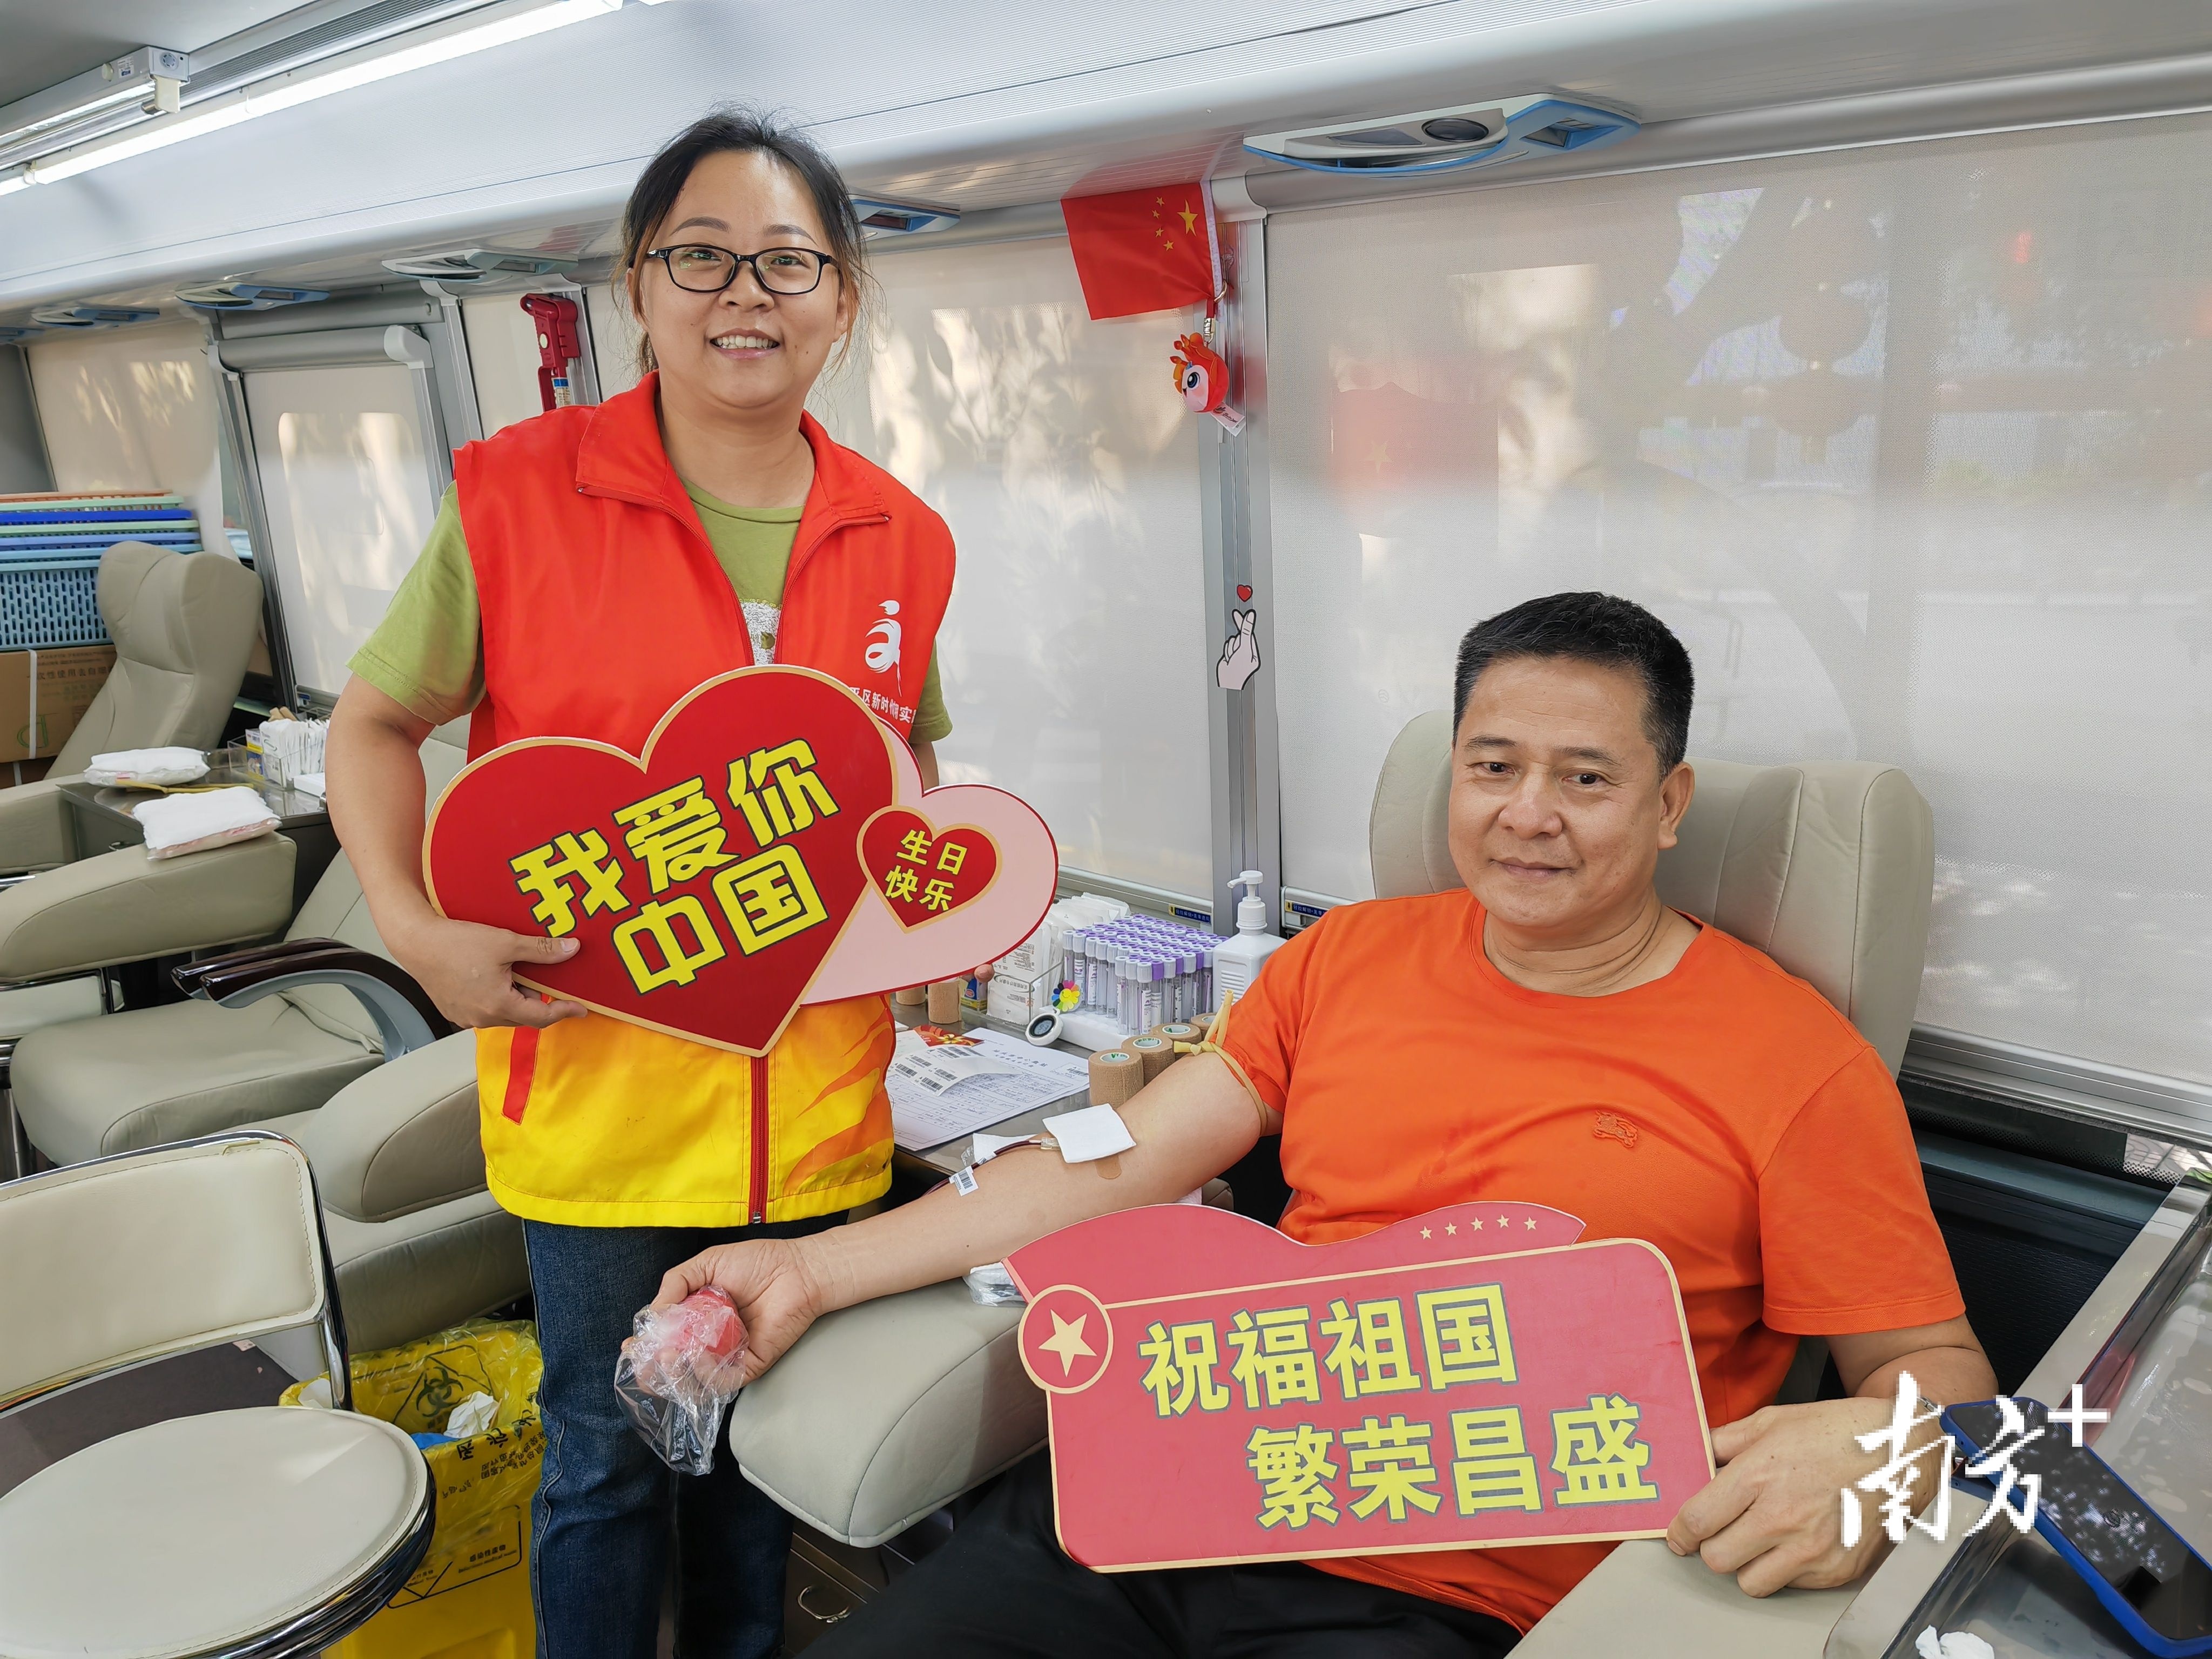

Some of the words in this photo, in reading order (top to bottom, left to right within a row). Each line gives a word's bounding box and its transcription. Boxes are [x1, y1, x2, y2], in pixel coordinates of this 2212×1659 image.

[510, 738, 840, 939] 我爱你
[884, 865, 955, 912] 快乐
[896, 829, 968, 875] 生日
[612, 843, 830, 995] 中国
[1138, 1283, 1518, 1418] 祝福祖国
[1246, 1392, 1658, 1530] 繁荣昌盛
